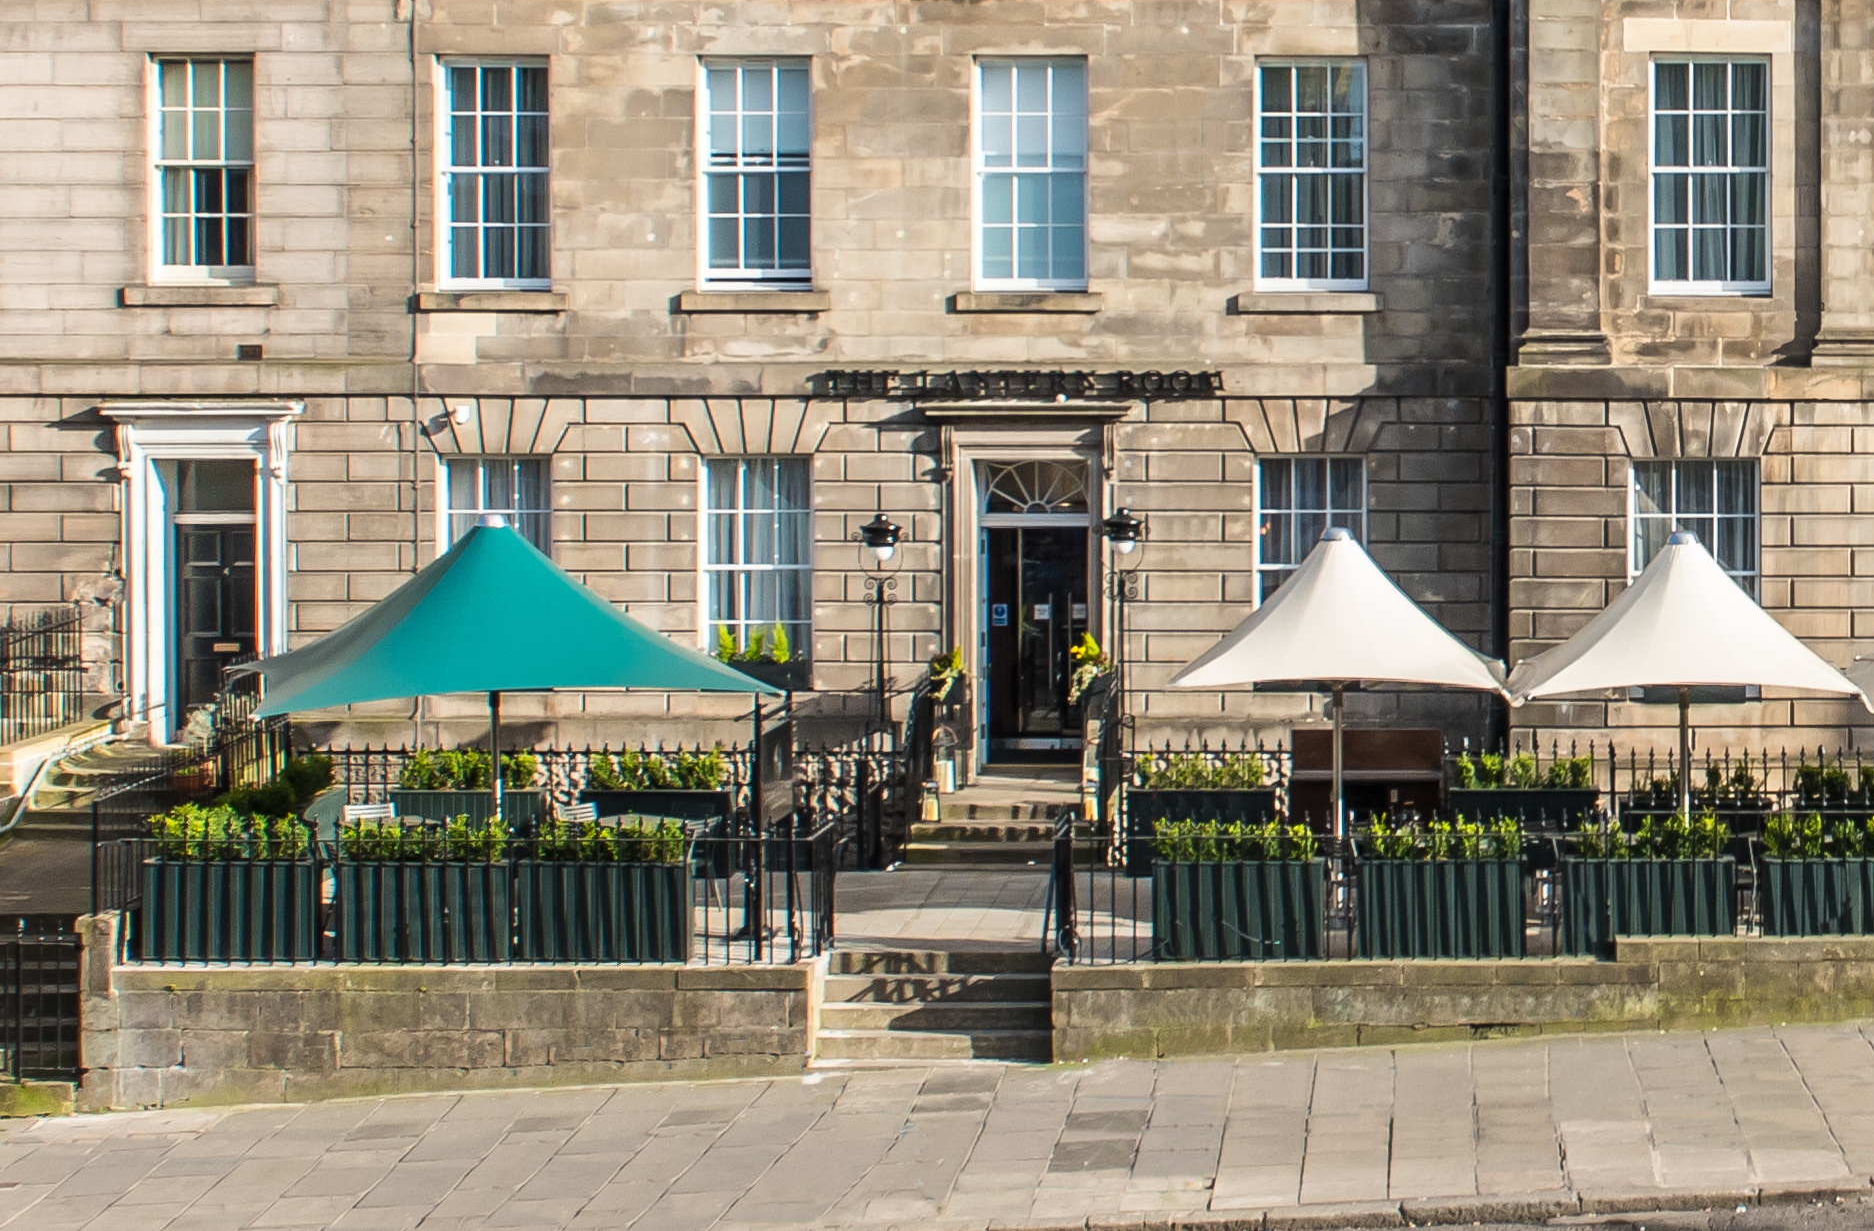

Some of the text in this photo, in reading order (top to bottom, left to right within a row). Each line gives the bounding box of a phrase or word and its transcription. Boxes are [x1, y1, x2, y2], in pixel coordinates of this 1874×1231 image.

[825, 369, 1226, 393] THE LANTERN ROOM
